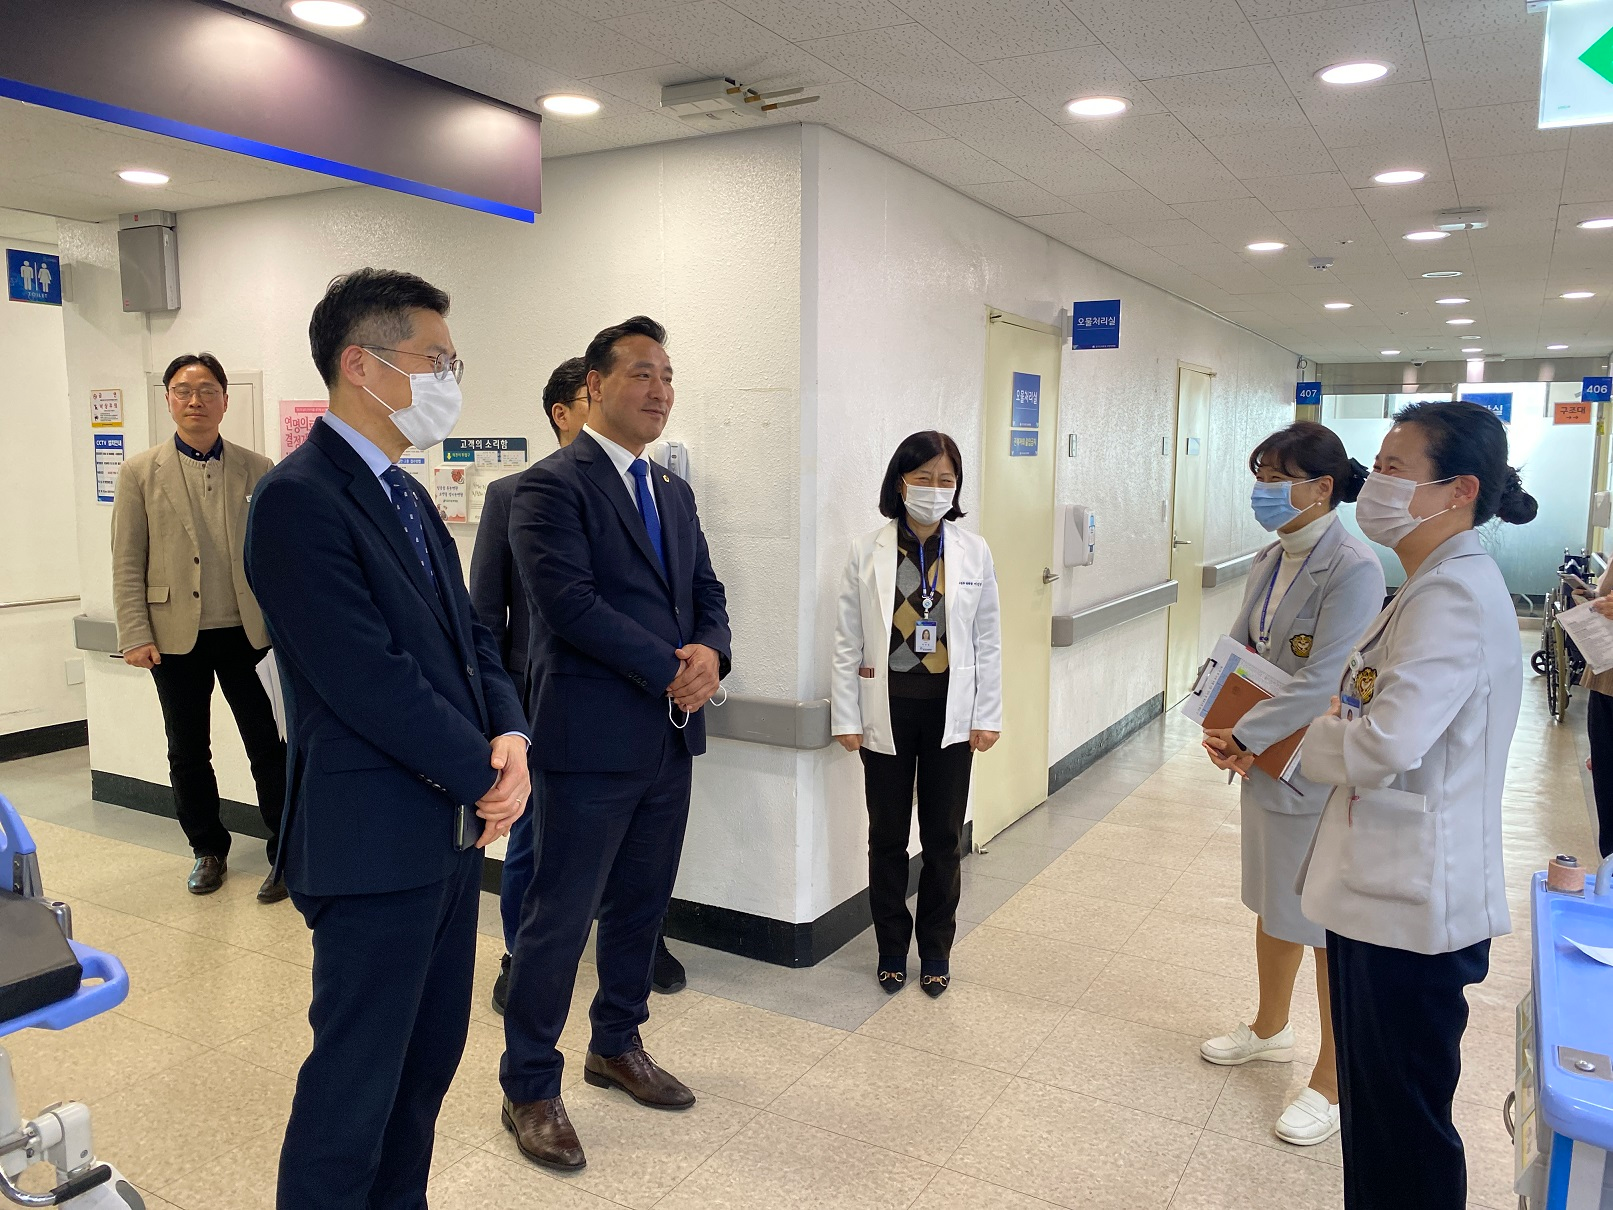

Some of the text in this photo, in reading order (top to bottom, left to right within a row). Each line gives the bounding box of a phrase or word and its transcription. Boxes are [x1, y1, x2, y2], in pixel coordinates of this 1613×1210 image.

[28, 291, 47, 299] TOILET
[1076, 316, 1116, 327] 오물처리실
[1300, 389, 1317, 398] 407
[1586, 384, 1608, 394] 406
[1015, 389, 1038, 405] 오물처리실
[1560, 406, 1586, 414] 구조대
[460, 439, 508, 450] 고객의 소리함
